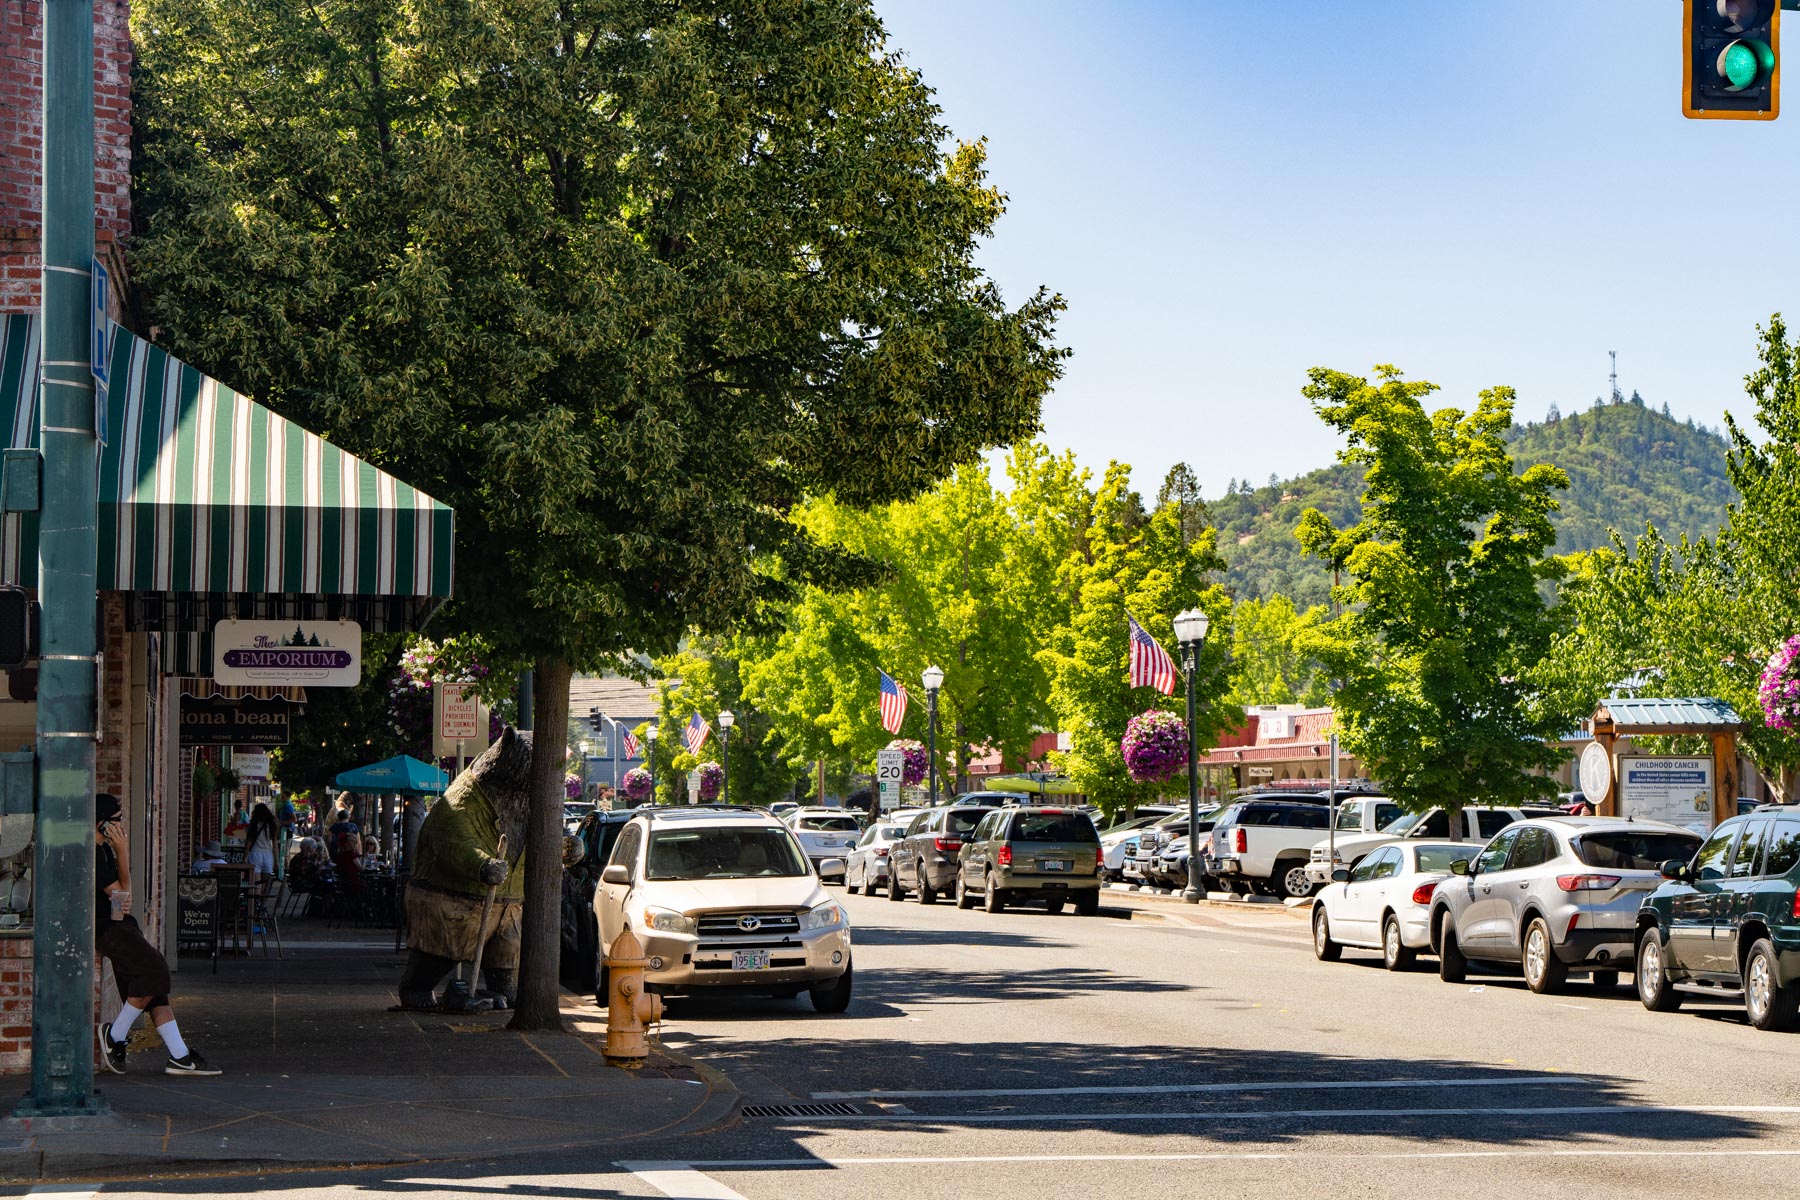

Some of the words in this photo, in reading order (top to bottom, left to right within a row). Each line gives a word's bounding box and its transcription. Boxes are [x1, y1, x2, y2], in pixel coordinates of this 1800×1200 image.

[254, 635, 276, 649] The
[239, 652, 337, 666] EMPORIUM
[179, 708, 227, 725] iona
[234, 708, 288, 725] bean
[1635, 761, 1673, 769] CHILDHOOD
[1674, 761, 1699, 769] CANCER
[880, 766, 900, 778] 20
[184, 910, 210, 918] We're
[184, 917, 209, 926] Open
